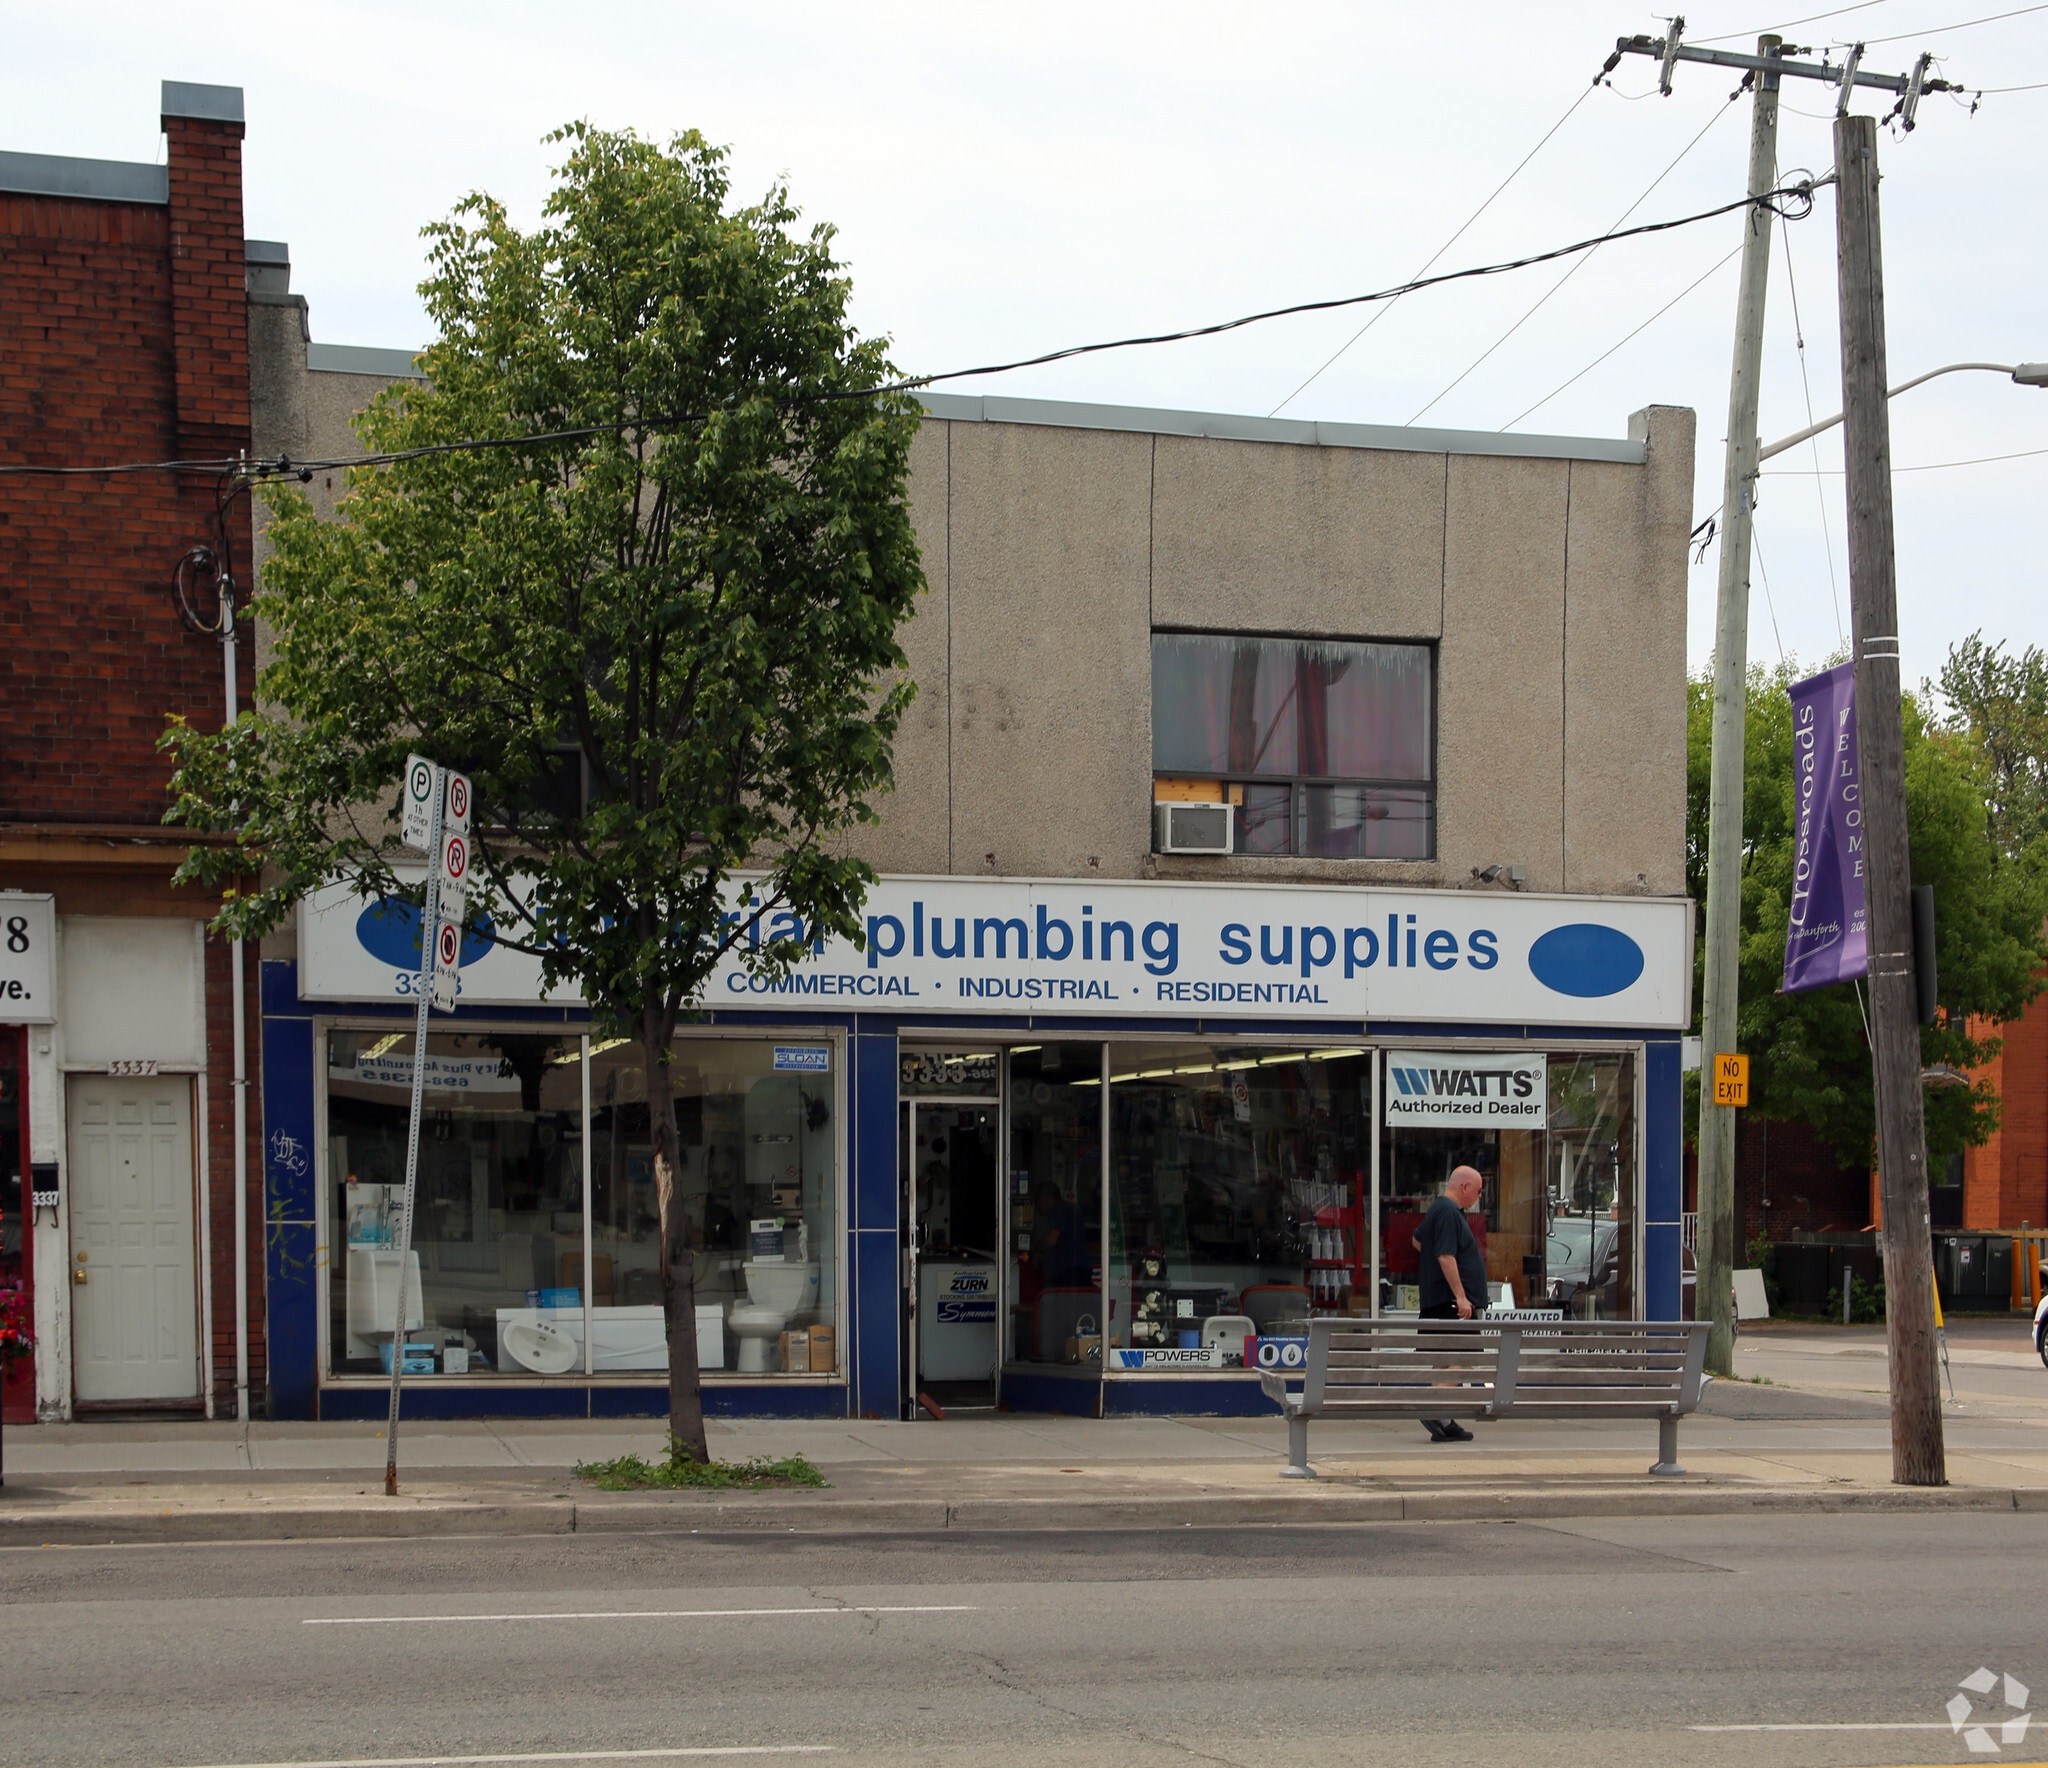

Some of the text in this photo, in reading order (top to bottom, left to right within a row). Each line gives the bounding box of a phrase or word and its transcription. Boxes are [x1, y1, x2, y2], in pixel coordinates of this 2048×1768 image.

[416, 771, 427, 792] P
[1837, 706, 1864, 878] WELCOME
[1790, 704, 1815, 926] Crossroads
[0, 916, 29, 953] 8
[1801, 920, 1840, 940] Danforth
[867, 902, 1179, 976] plumbing
[1218, 913, 1499, 979] supplies
[727, 971, 1328, 1004] COMMERCIAL INDUSTRIAL RESIDENTIAL
[111, 1060, 157, 1075] 3337
[777, 1053, 825, 1064] SLOAN
[902, 1060, 964, 1084] 3333
[1723, 1062, 1739, 1077] NO
[1718, 1082, 1743, 1099] EXIT
[1389, 1099, 1541, 1115] Authorized Dealer
[32, 1191, 59, 1206] 3337
[950, 1279, 989, 1291] ZURN
[938, 1302, 996, 1322] Symmon
